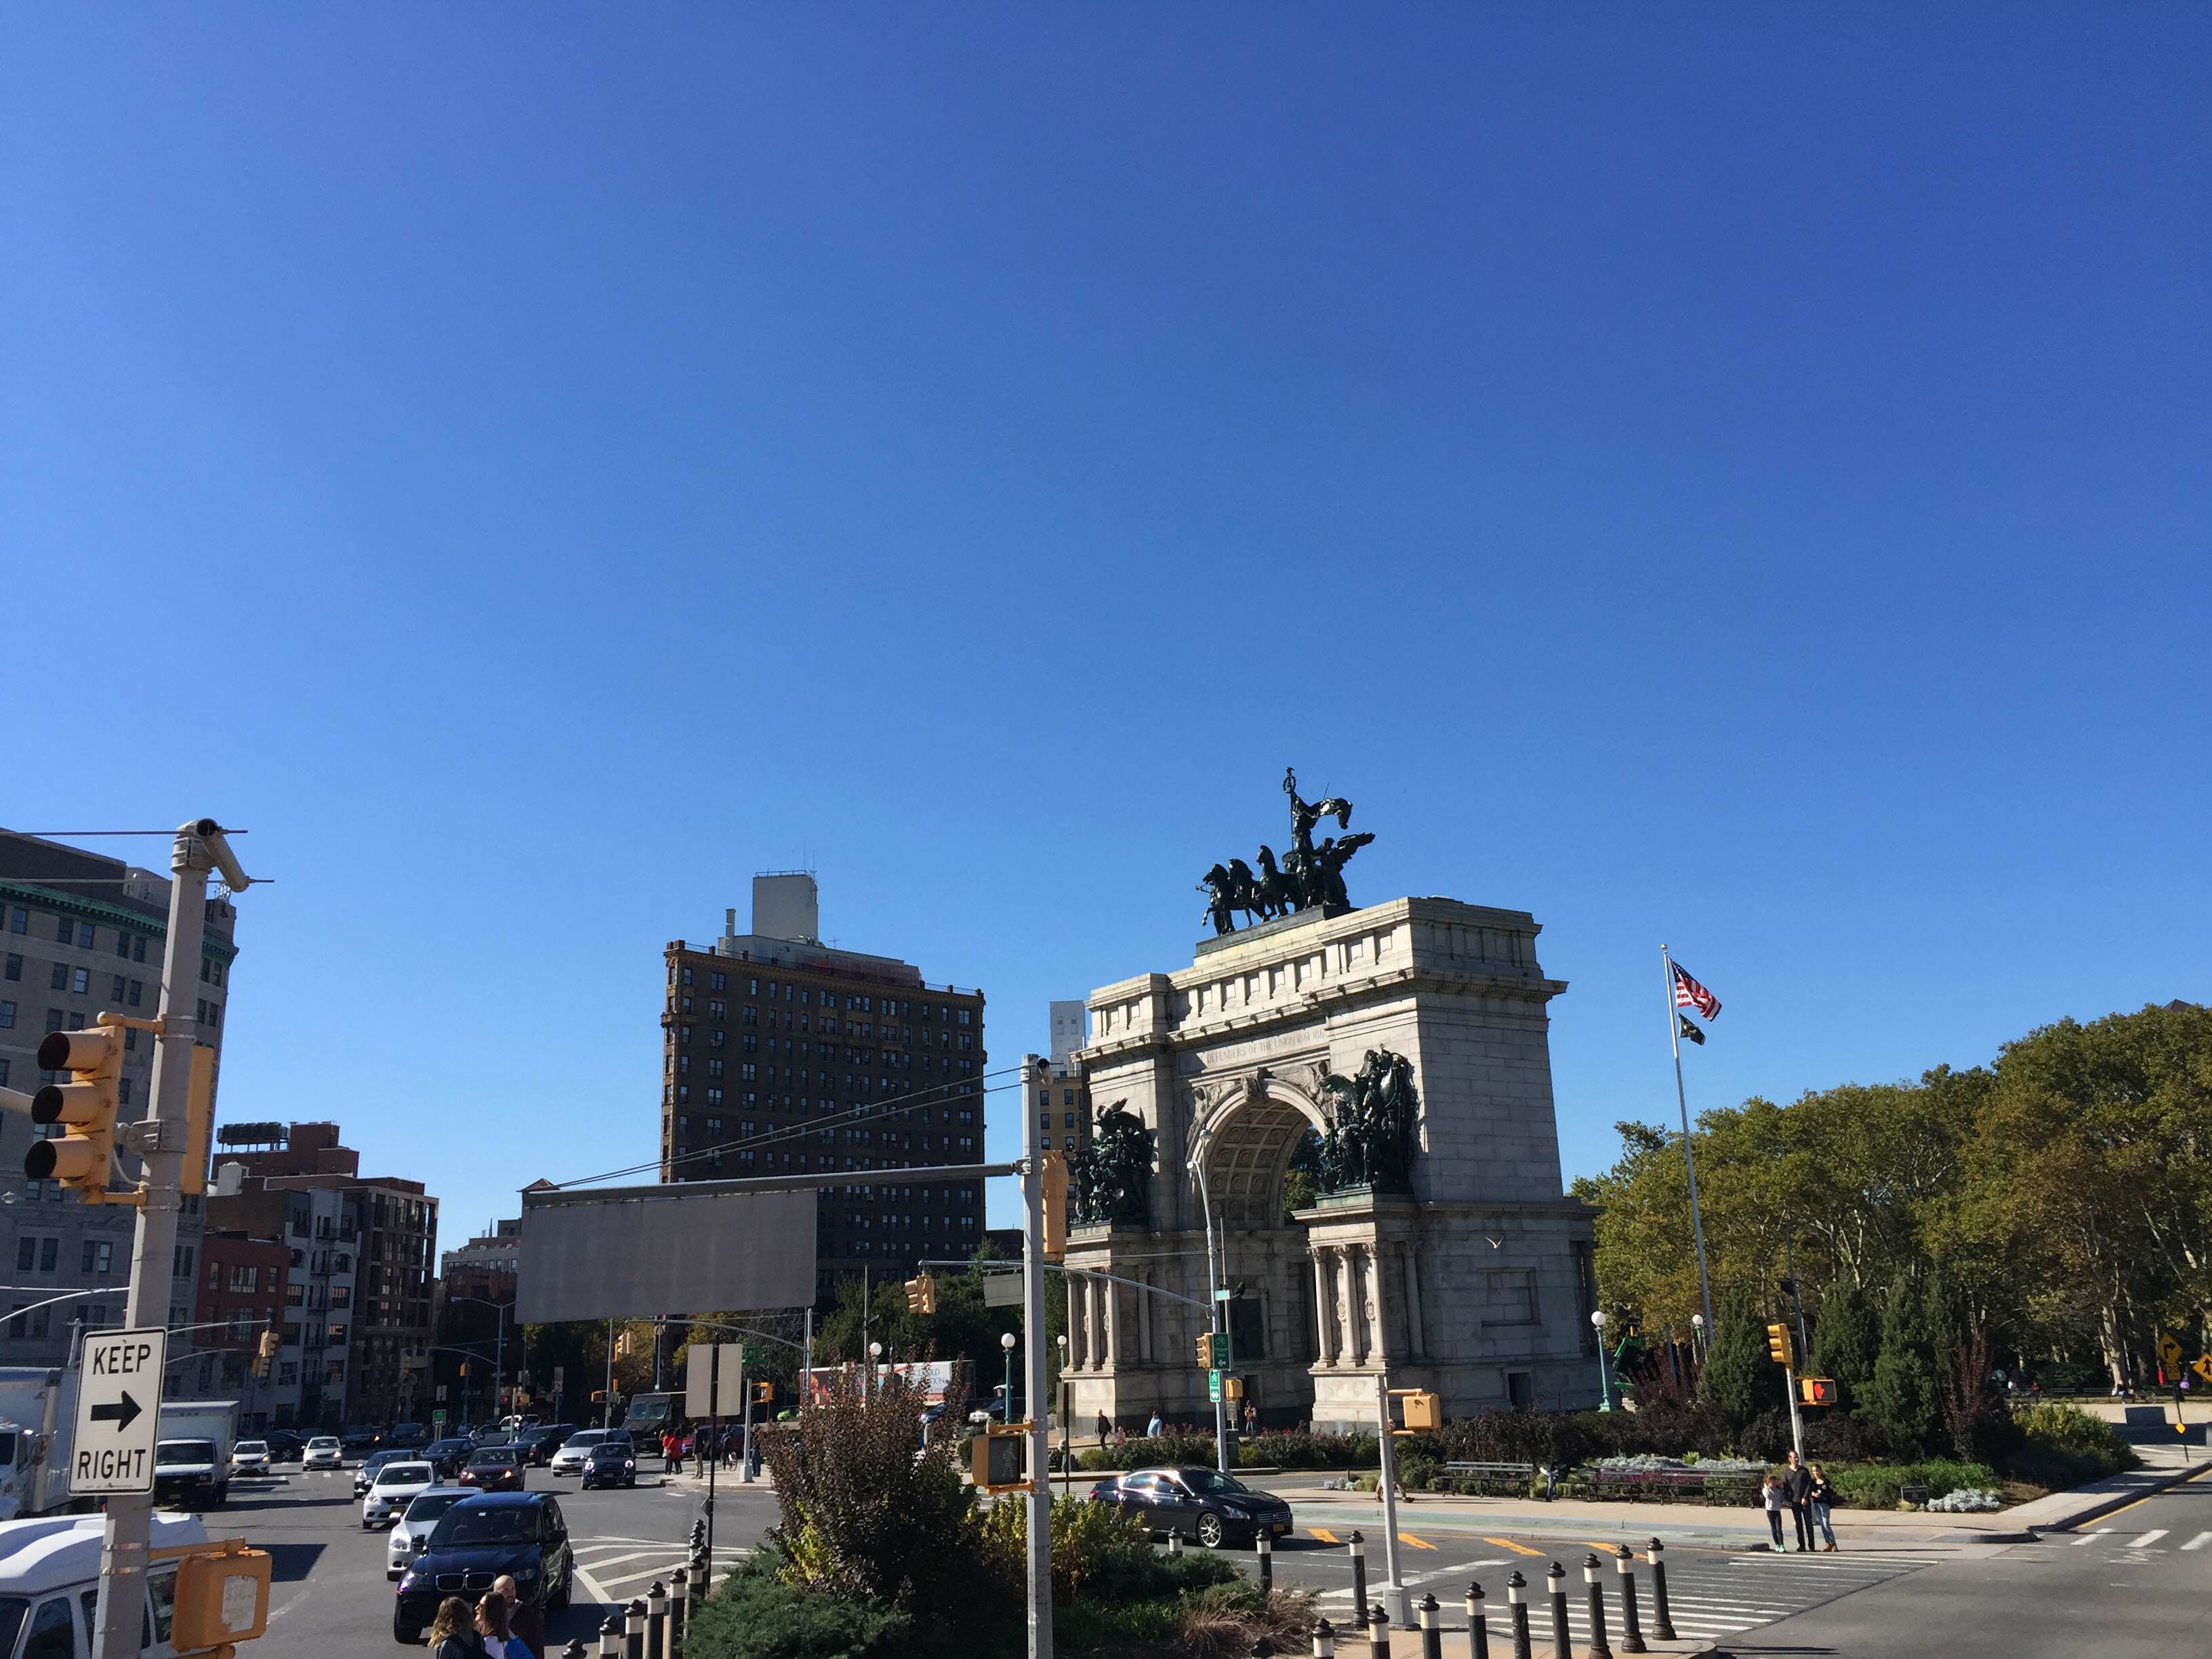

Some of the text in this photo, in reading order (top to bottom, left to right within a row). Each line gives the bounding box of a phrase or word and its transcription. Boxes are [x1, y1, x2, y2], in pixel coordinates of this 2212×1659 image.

[1207, 1046, 1247, 1063] DEFENDERS
[1249, 1044, 1257, 1053] OF
[1259, 1039, 1273, 1052] THE
[1275, 1034, 1296, 1048] UNION
[93, 1345, 150, 1374] KEEP
[77, 1449, 146, 1479] RIGHT
